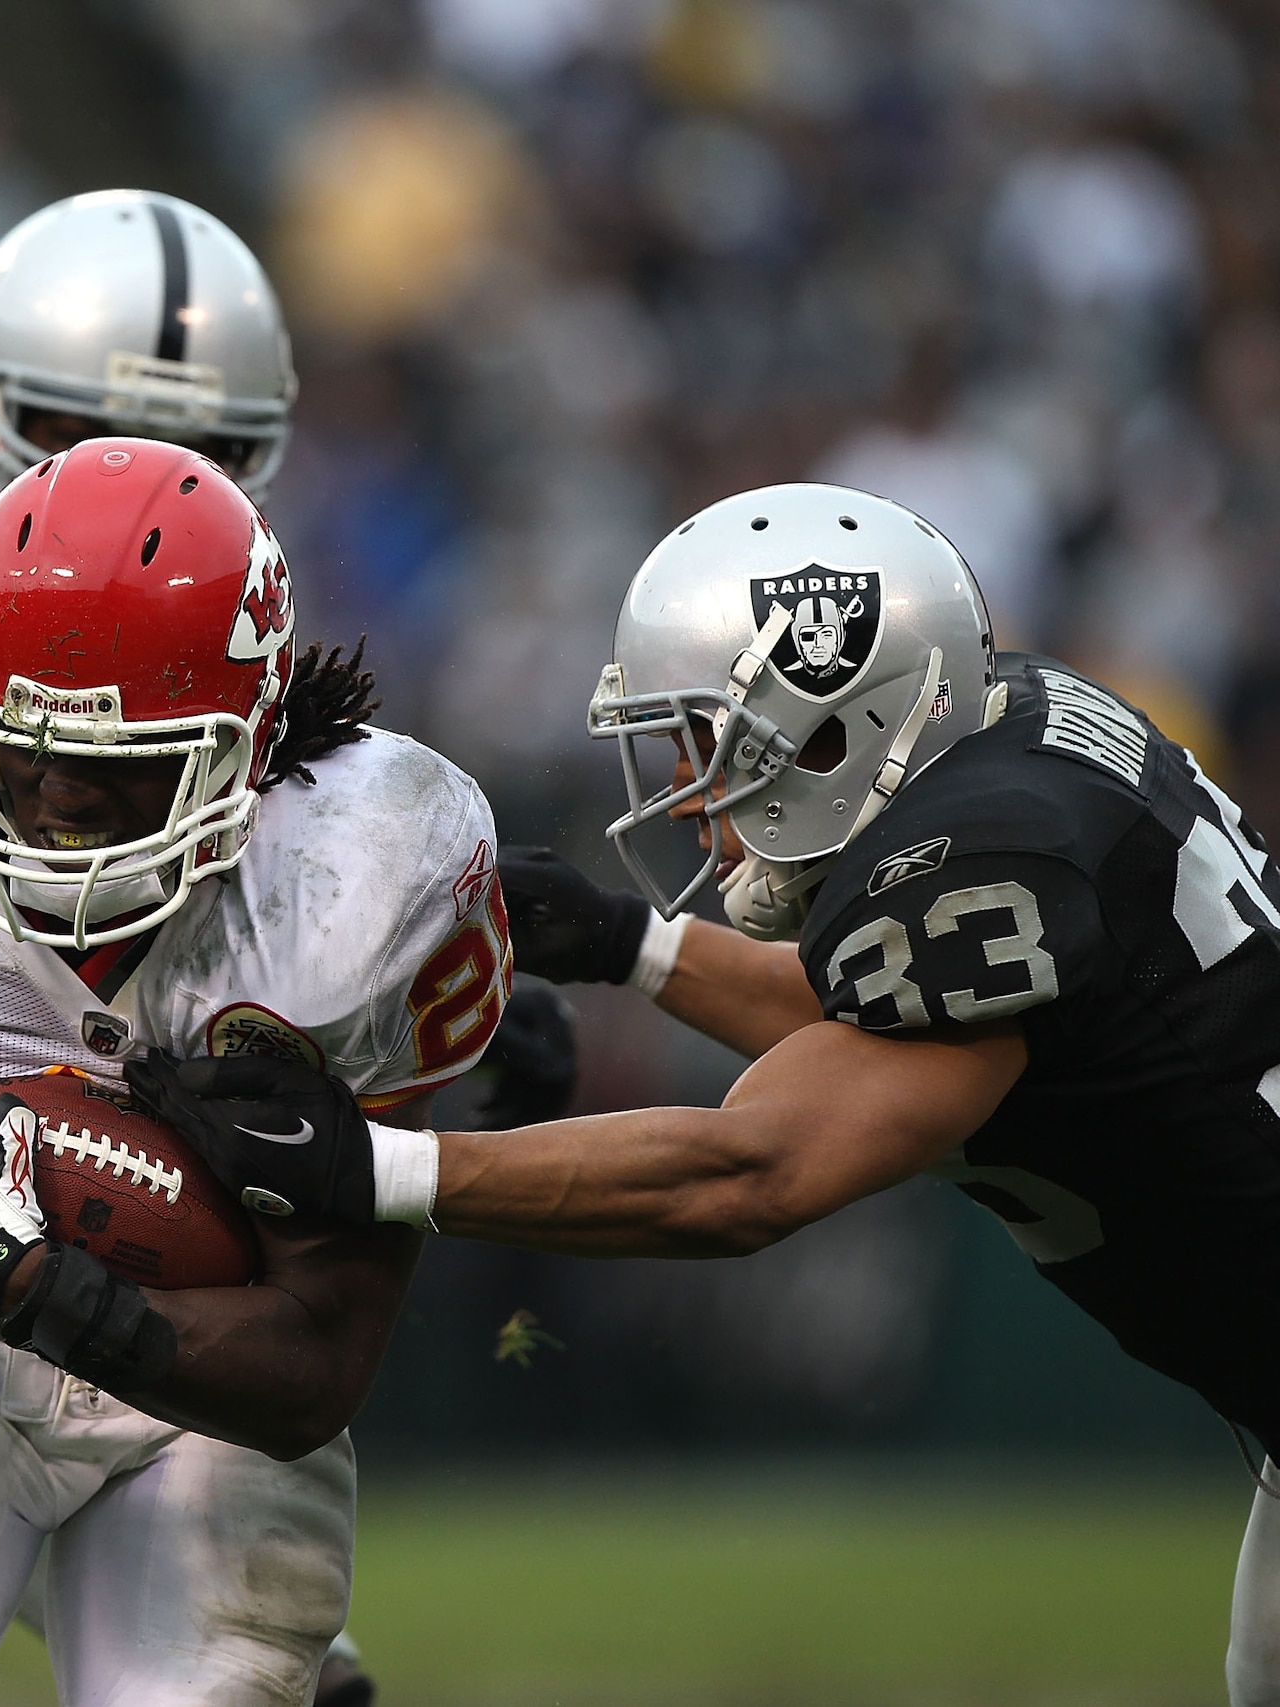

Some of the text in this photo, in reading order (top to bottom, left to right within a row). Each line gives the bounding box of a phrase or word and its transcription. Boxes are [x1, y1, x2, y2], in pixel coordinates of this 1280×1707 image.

[762, 575, 869, 596] RAIDERS
[32, 693, 94, 714] Riddell
[826, 879, 1061, 1031] 33
